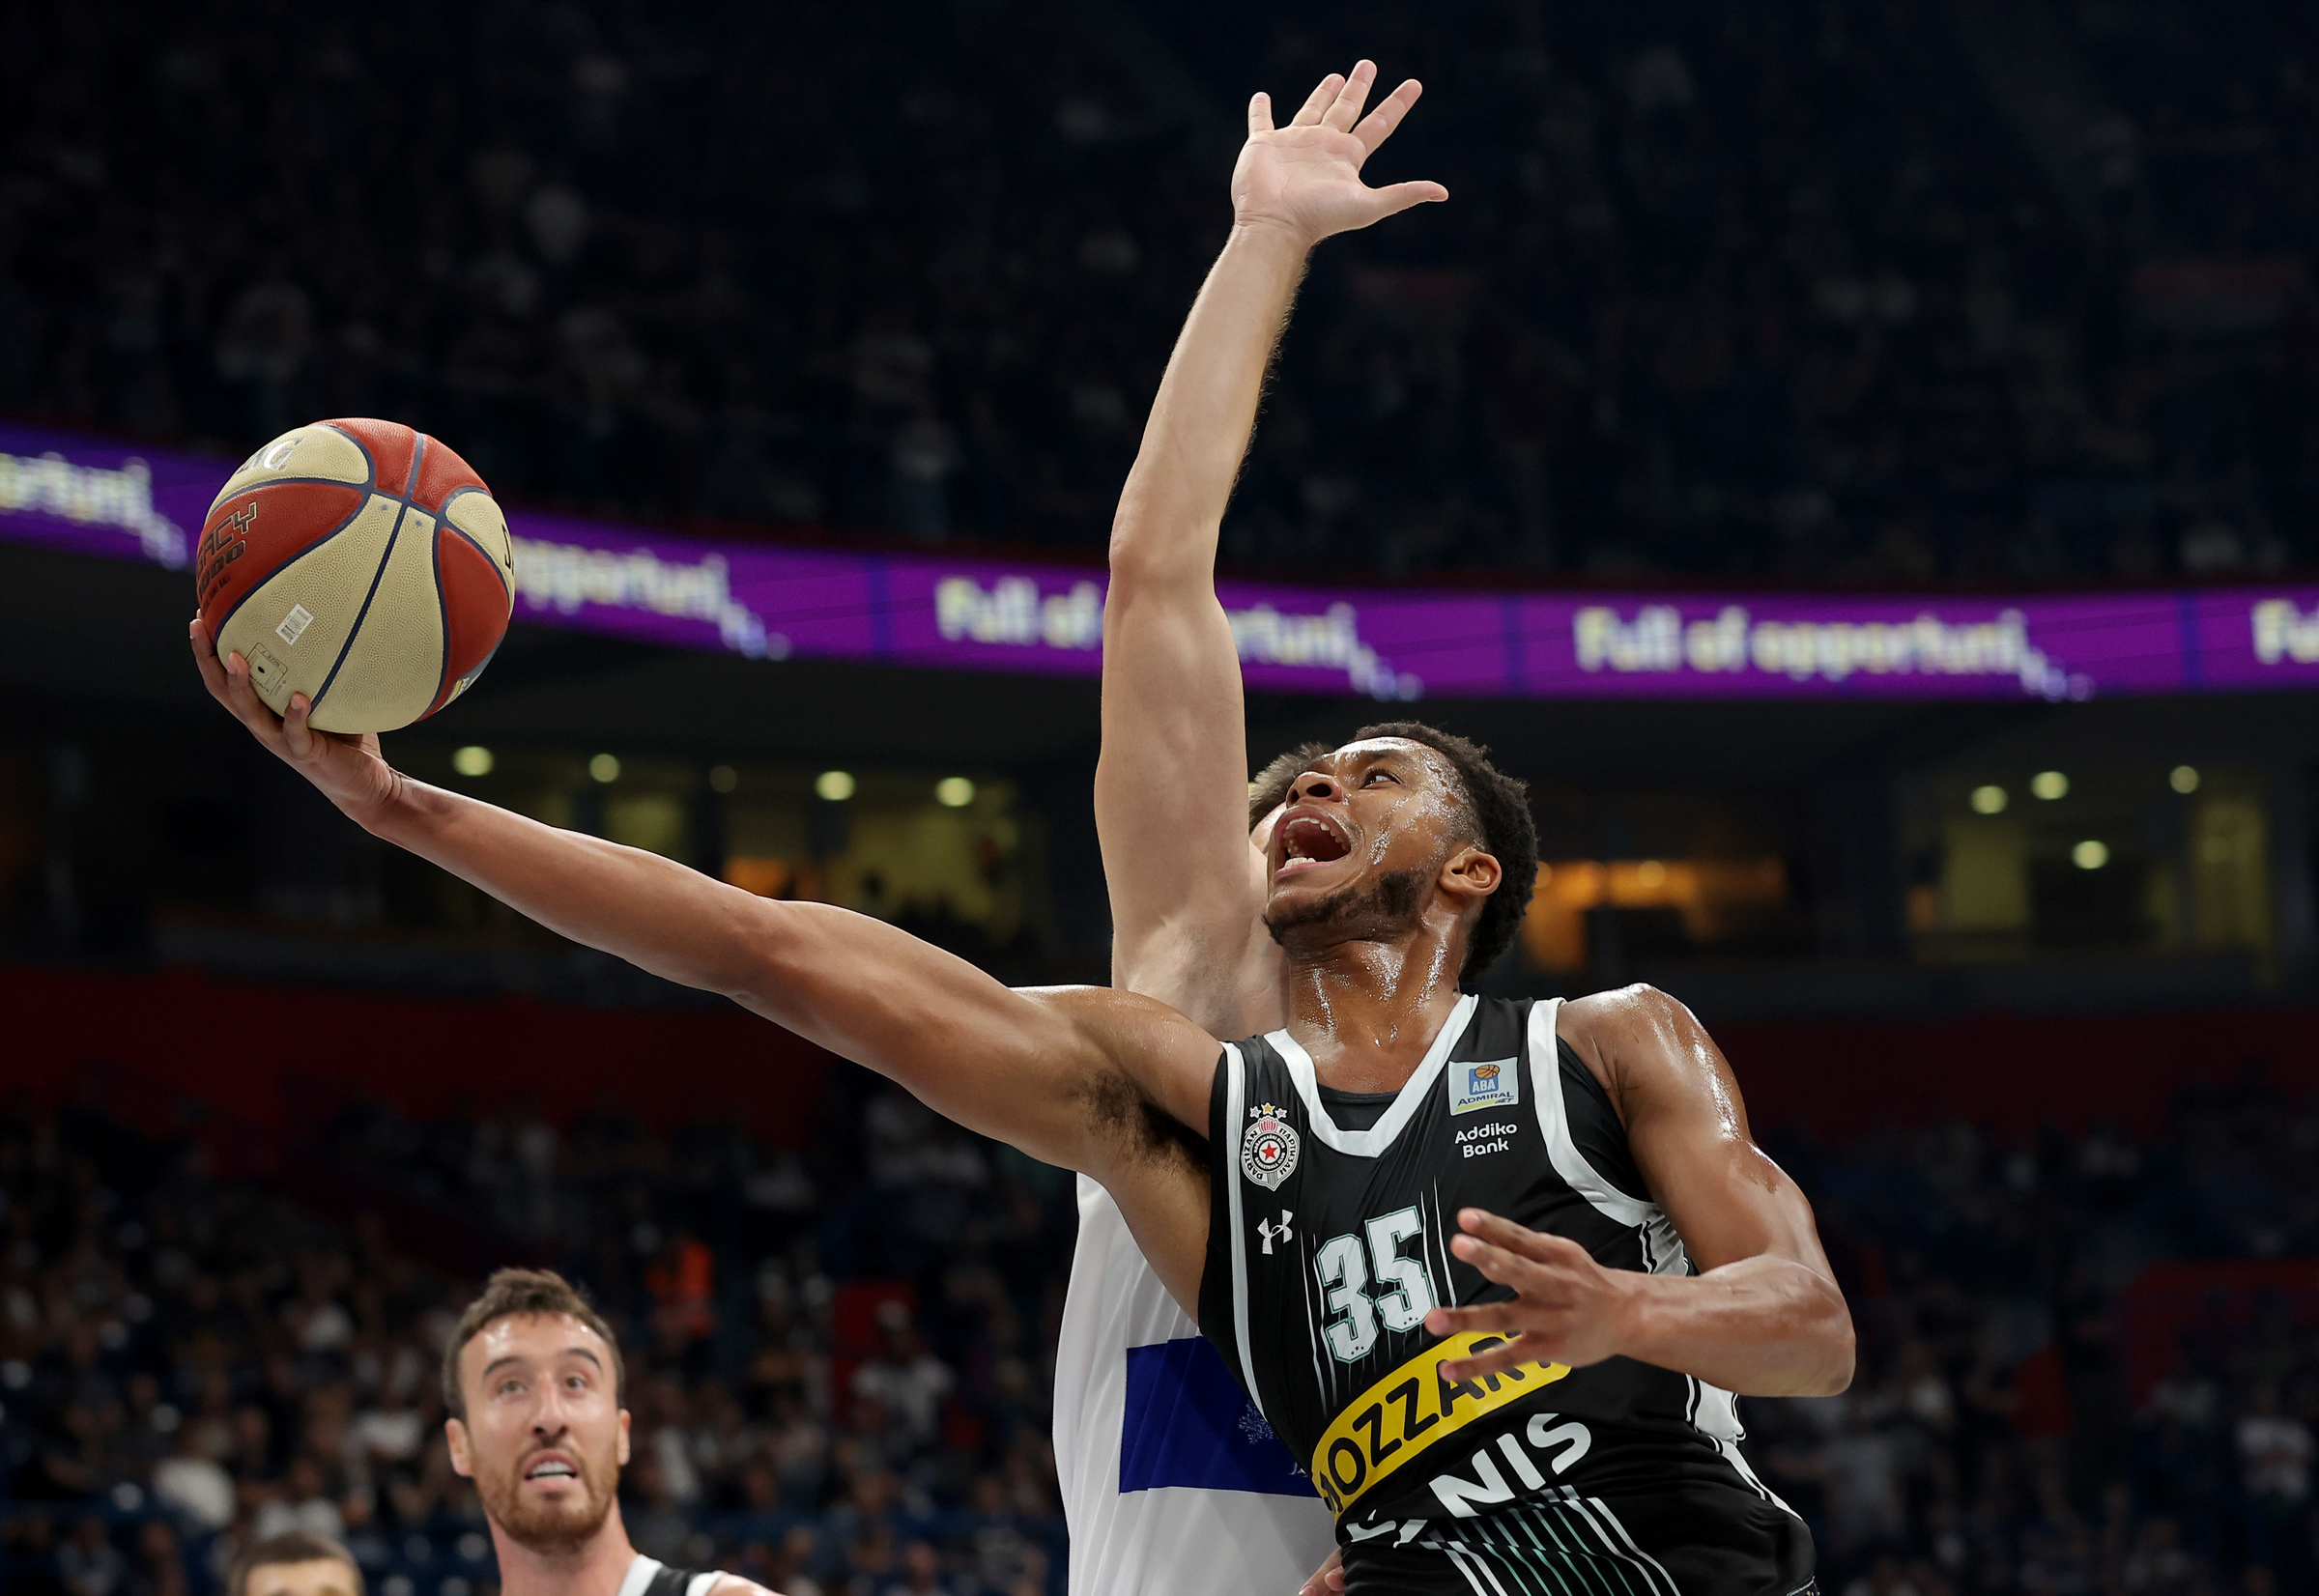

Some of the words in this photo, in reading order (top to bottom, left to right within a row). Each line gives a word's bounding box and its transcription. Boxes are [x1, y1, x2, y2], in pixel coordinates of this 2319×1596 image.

[1573, 605, 1682, 673] Full
[1685, 604, 1747, 672] of
[1457, 1091, 1515, 1107] ADMIRAL
[1472, 1078, 1497, 1094] ABA
[1244, 1129, 1264, 1181] PARTIZAN
[1278, 1127, 1297, 1176] ПАРТИЗАН
[1454, 1122, 1518, 1145] Addiko
[1462, 1137, 1510, 1159] Bank
[1316, 1205, 1435, 1364] 35
[1428, 1412, 1591, 1519] NIS
